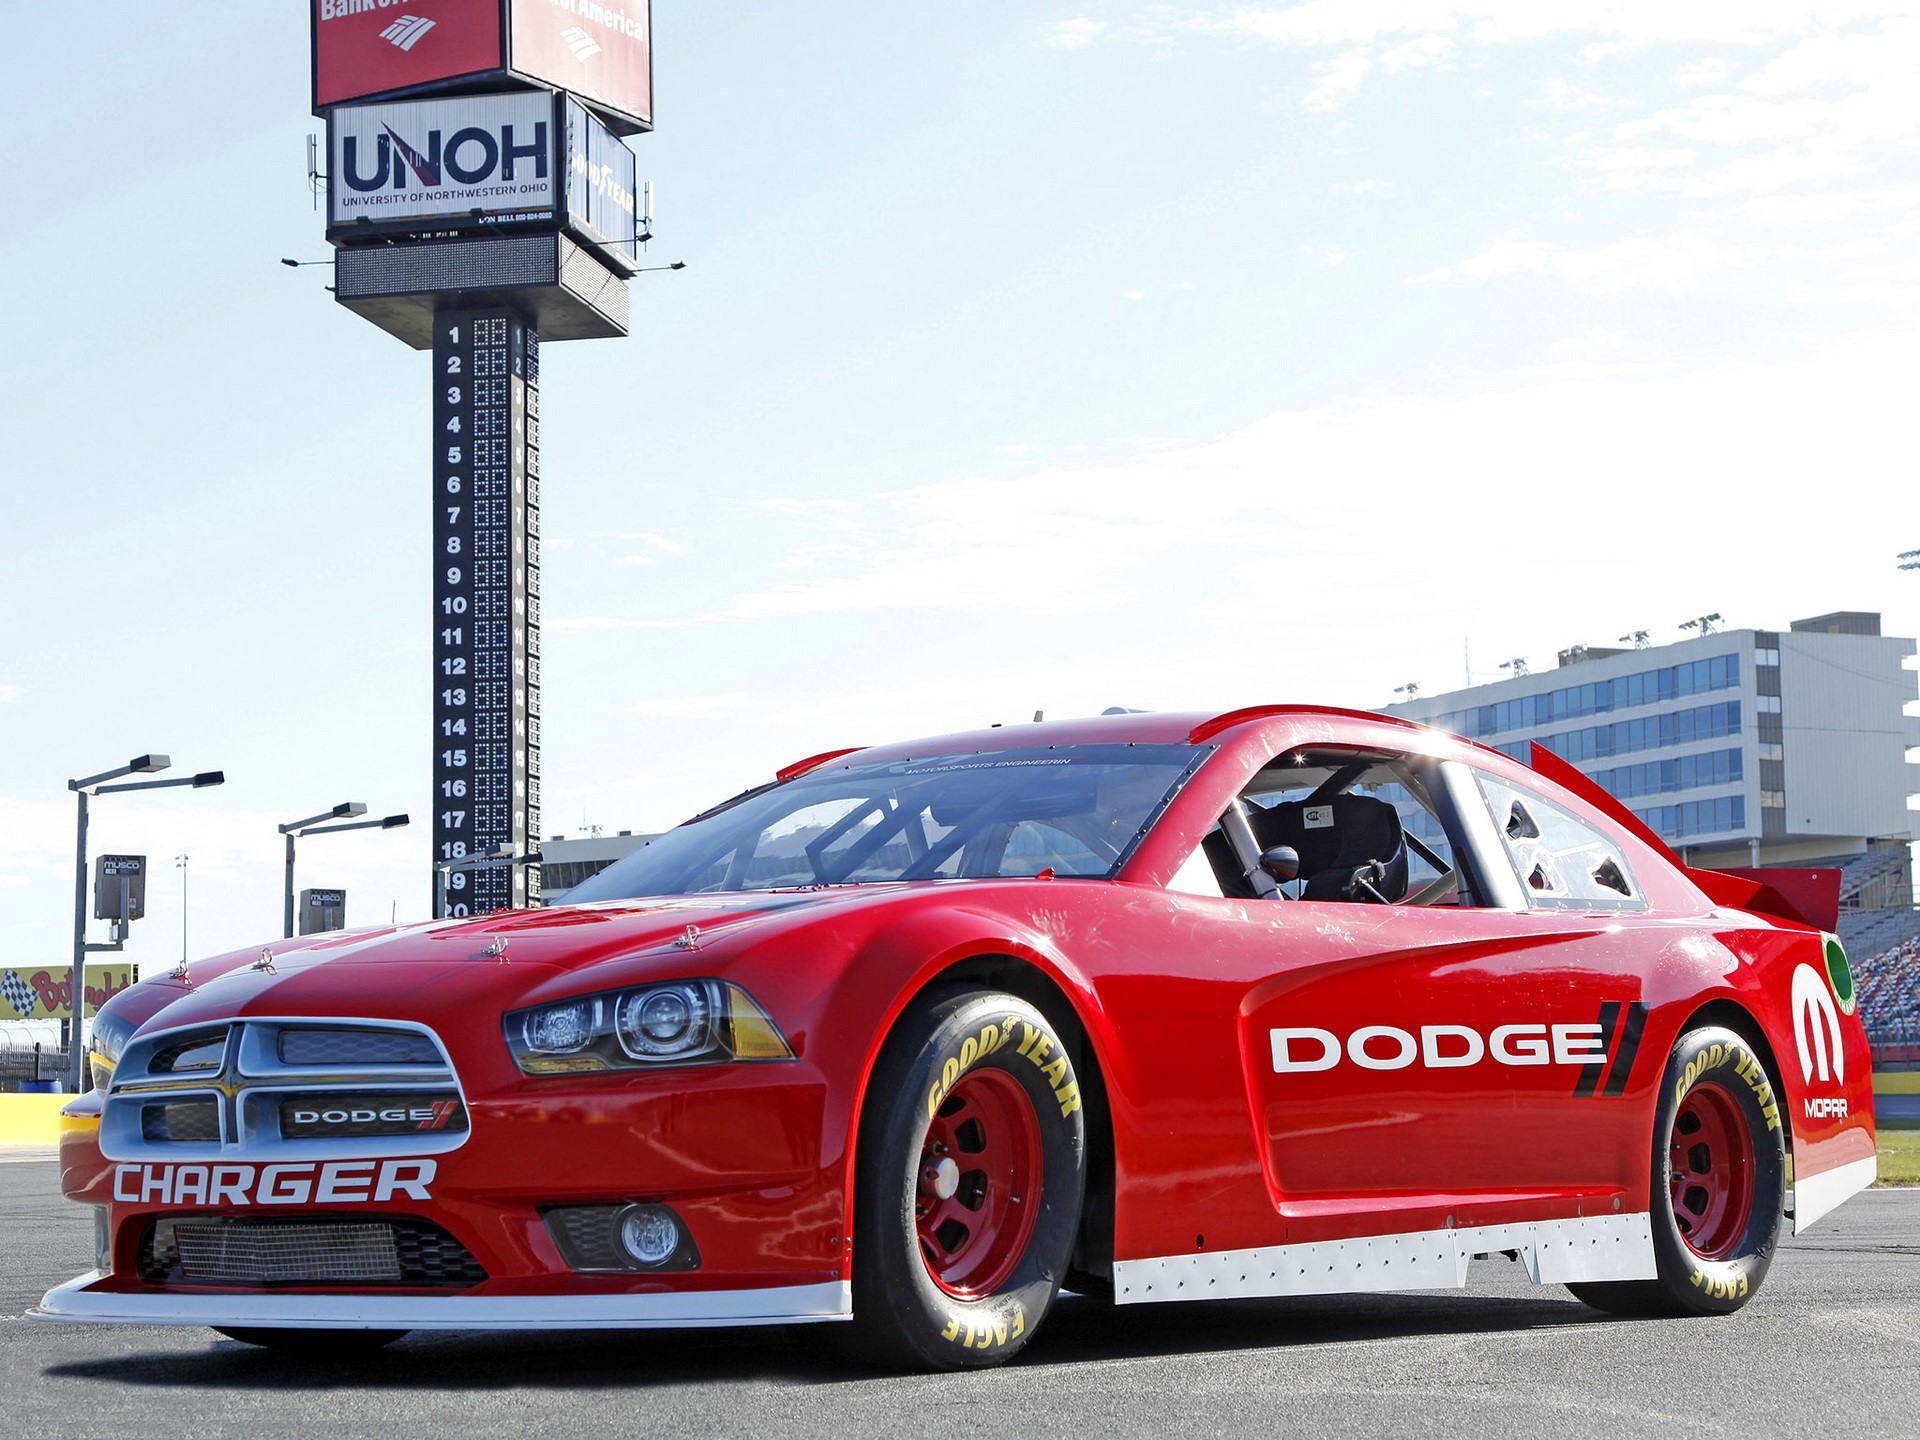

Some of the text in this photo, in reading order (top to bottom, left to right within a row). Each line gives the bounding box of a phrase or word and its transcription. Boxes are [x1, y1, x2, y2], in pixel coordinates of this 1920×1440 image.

[343, 120, 548, 192] UNOH
[343, 183, 548, 206] UNIVERSITY OF NORTHWESTERN OHIO
[450, 327, 458, 343] 1
[515, 328, 521, 345] 1
[447, 357, 460, 373] 2
[515, 357, 521, 375] 2
[447, 387, 460, 403] 3
[447, 417, 460, 433] 4
[515, 417, 522, 434] 4
[448, 447, 461, 463] 5
[515, 447, 522, 464] 5
[447, 477, 460, 493] 6
[447, 507, 460, 523] 7
[515, 507, 522, 524] 7
[447, 537, 460, 553] 8
[447, 568, 461, 584] 9
[442, 597, 467, 613] 10
[442, 627, 462, 644] 11
[442, 658, 466, 674] 12
[442, 688, 466, 705] 13
[442, 719, 466, 735] 14
[442, 750, 466, 766] 15
[442, 780, 466, 796] 16
[442, 811, 465, 828] 17
[442, 841, 466, 858] 18
[1270, 1024, 1608, 1073] DODGE
[294, 1108, 435, 1124] DODGE
[1804, 1098, 1848, 1118] MOPAR
[113, 1159, 438, 1205] CHARGER
[1689, 1264, 1749, 1300] EAGLE
[941, 1303, 1025, 1349] EAGLE
